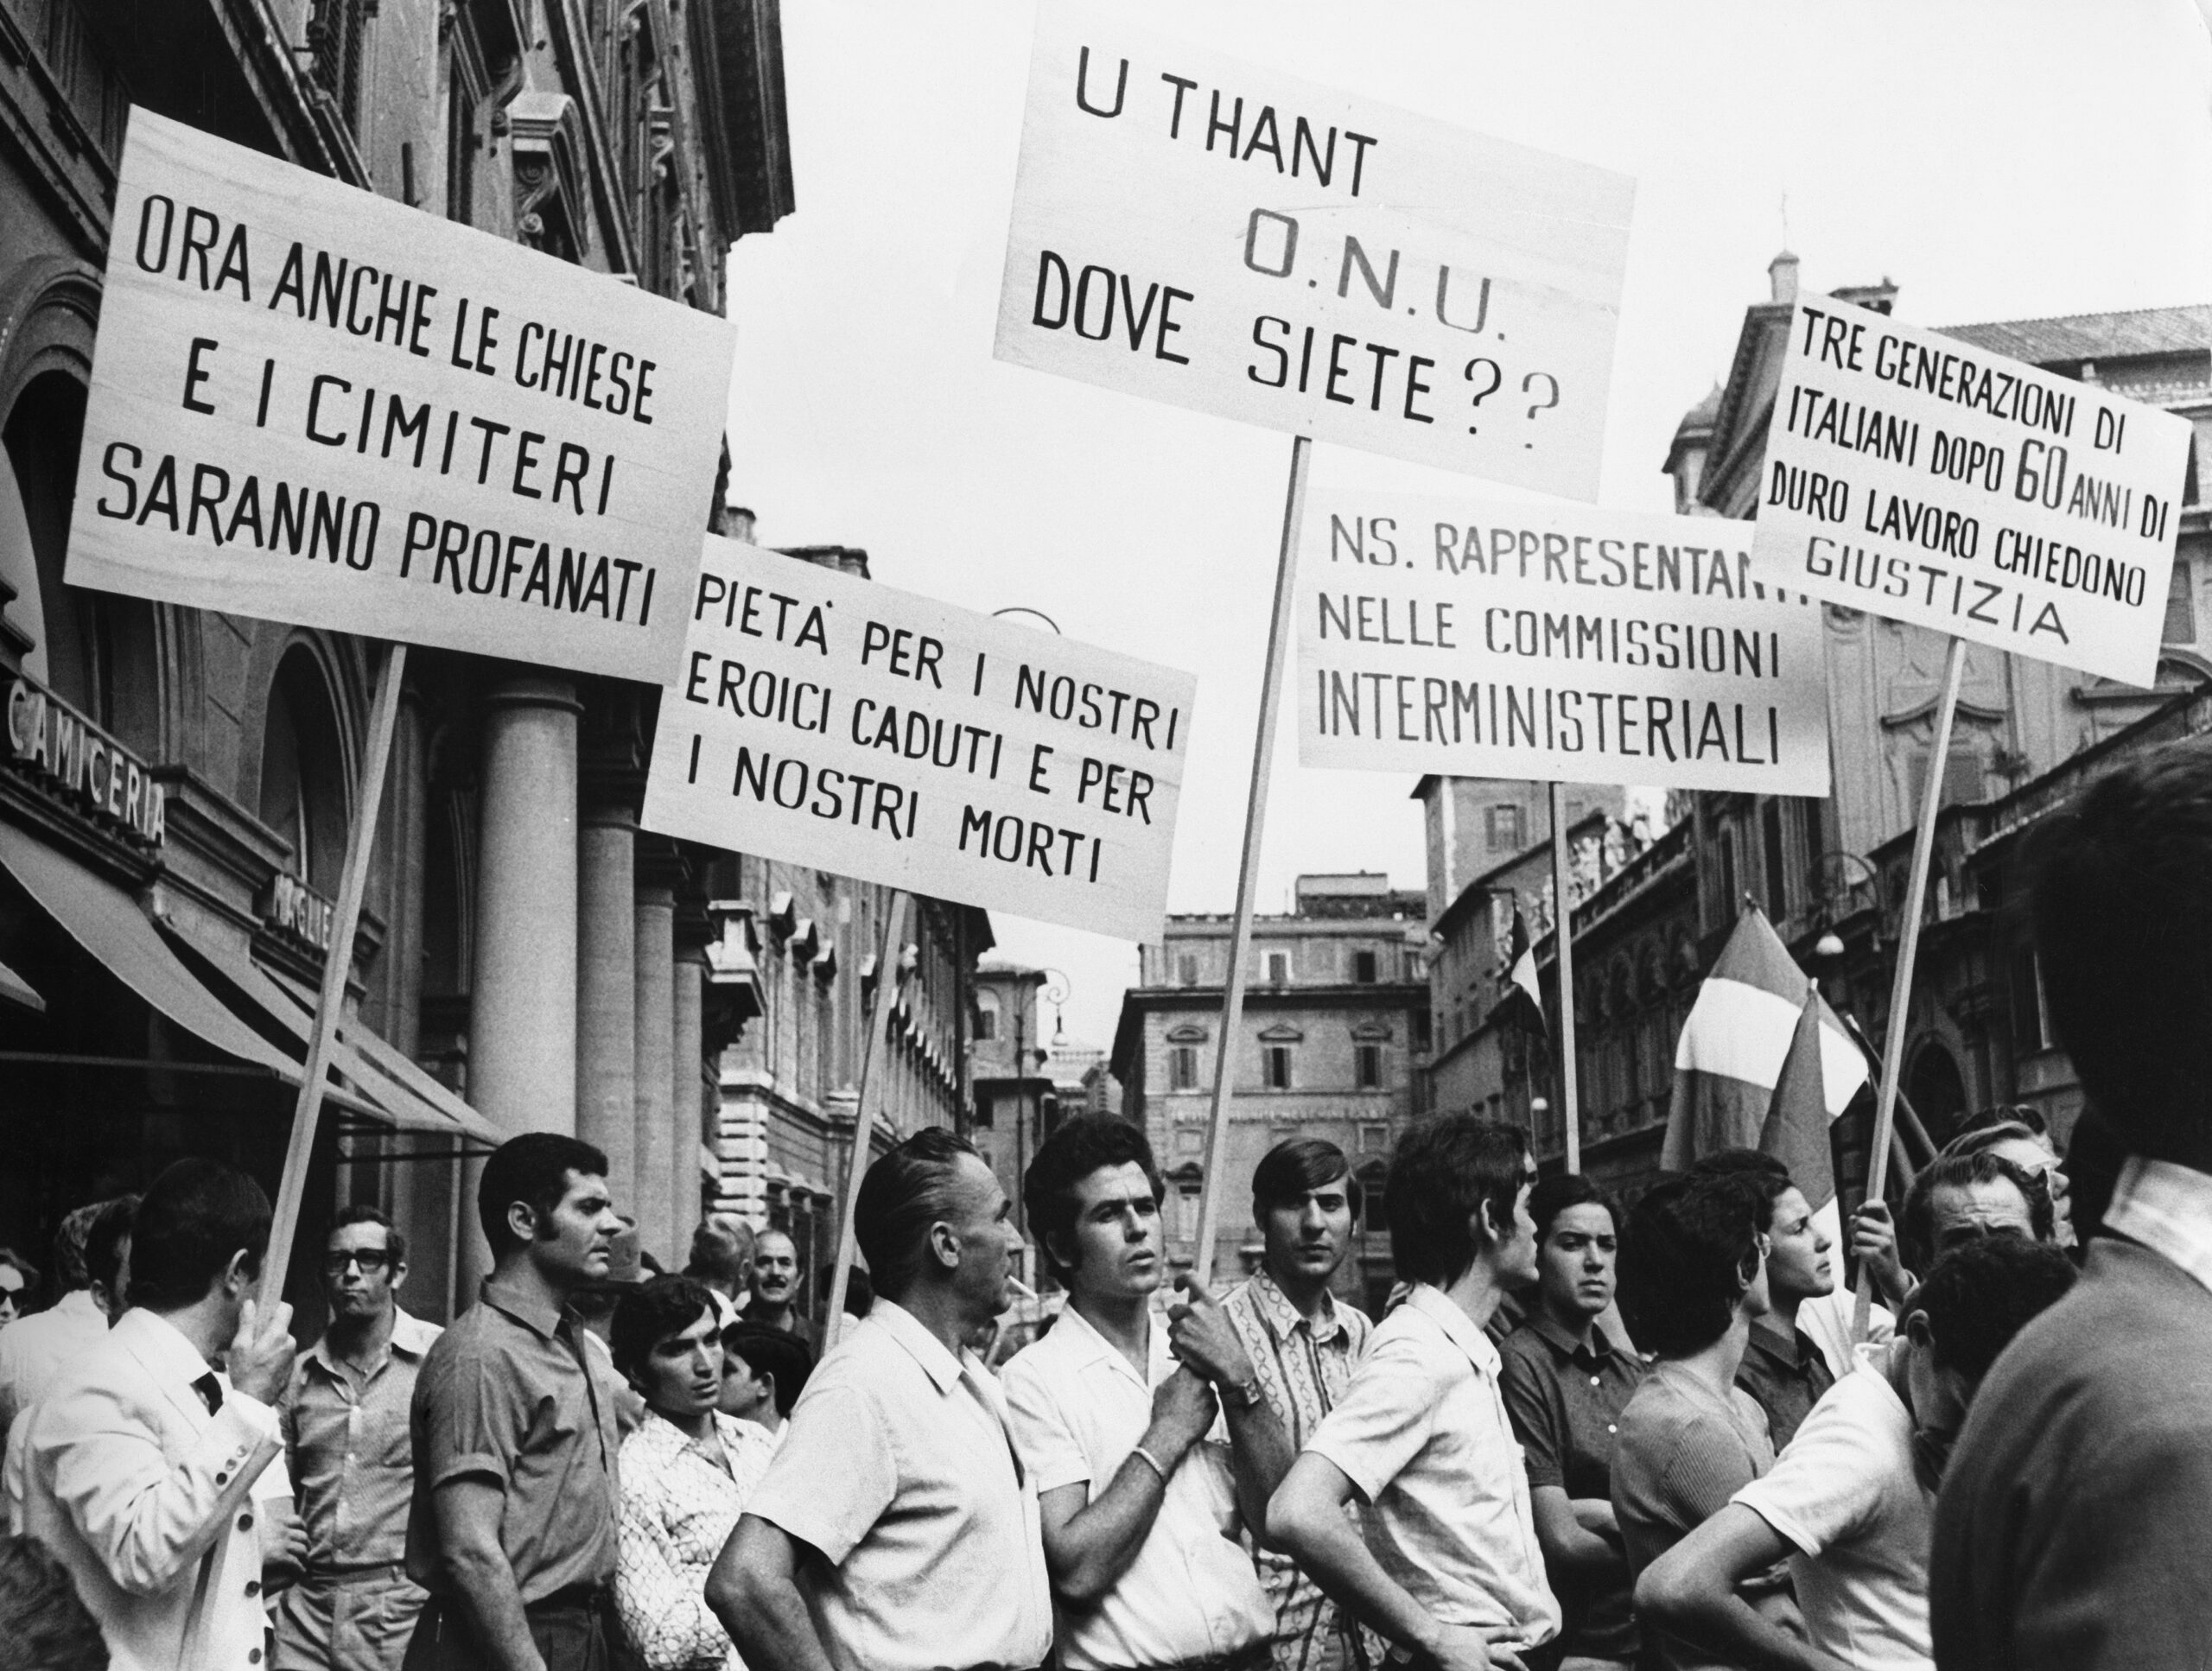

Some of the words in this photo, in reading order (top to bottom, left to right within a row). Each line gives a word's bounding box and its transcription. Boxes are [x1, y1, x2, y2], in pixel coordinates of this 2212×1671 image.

[1076, 46, 1128, 118] U
[1161, 73, 1377, 198] THANT
[136, 194, 250, 302] ORA
[269, 243, 436, 358] ANCHE
[452, 298, 498, 377] LE
[516, 322, 657, 424] CHIESE
[1033, 250, 1195, 365] DOVE
[1802, 307, 1865, 371] TRE
[1875, 334, 2075, 436] GENERAZIONI
[2094, 406, 2125, 454] DI
[181, 337, 219, 416] E
[256, 359, 275, 428] I
[307, 374, 615, 516] CIMITERI
[1788, 385, 1918, 467] ITALIANI
[1930, 430, 2004, 492] DOPO
[2015, 438, 2068, 509] 60
[2068, 473, 2132, 530] ANNI
[2139, 494, 2168, 541] DI
[96, 442, 379, 571] SARANNO
[401, 511, 657, 626] PROFANATI
[1330, 513, 1414, 569] NS.
[1434, 522, 1808, 605] RAPPRESENTAN
[1767, 461, 1849, 523] DURO
[1865, 490, 1979, 559] LAVORO
[1994, 528, 2145, 607] CHIEDONO
[1806, 537, 2069, 645] GIUSTIZIA
[861, 621, 944, 689] PER
[973, 653, 985, 697] I
[1015, 664, 1179, 750] NOSTRI
[1319, 592, 1457, 648] NELLE
[1485, 607, 1778, 678] COMMISSIONI
[8, 679, 165, 846] CAMICERIA
[686, 651, 831, 734] EROICI
[852, 698, 1002, 779] CADUTI
[1029, 744, 1053, 794] E
[1077, 758, 1154, 825] PER
[1318, 669, 1778, 765] INTERMINISTERIALI
[689, 734, 702, 785] I
[733, 747, 918, 841] NOSTRI
[958, 804, 1101, 883] MORTI
